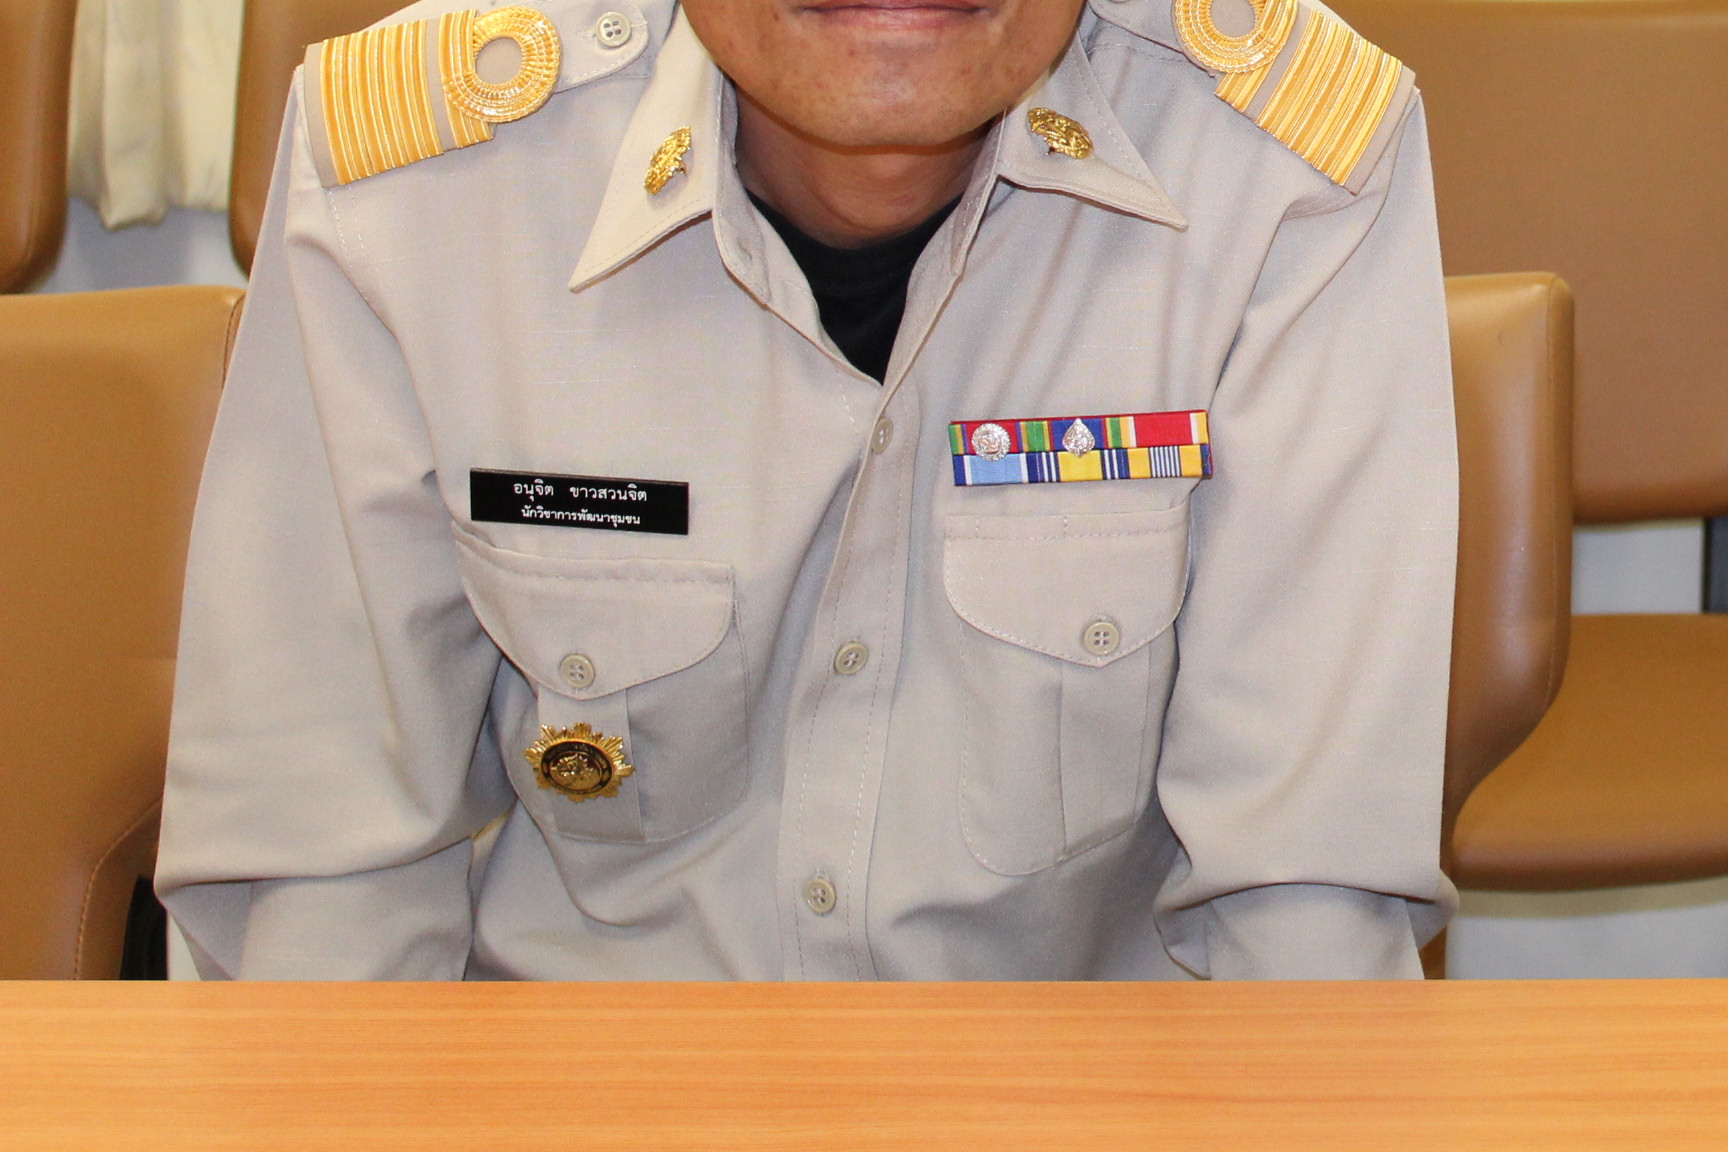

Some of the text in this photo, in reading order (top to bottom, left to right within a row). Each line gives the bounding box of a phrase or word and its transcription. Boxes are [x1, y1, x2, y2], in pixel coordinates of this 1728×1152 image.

[513, 479, 648, 502] อนุจิต ขาวสวนจิต
[521, 505, 641, 528] นักวิชาการพัฒนาชุมชน
